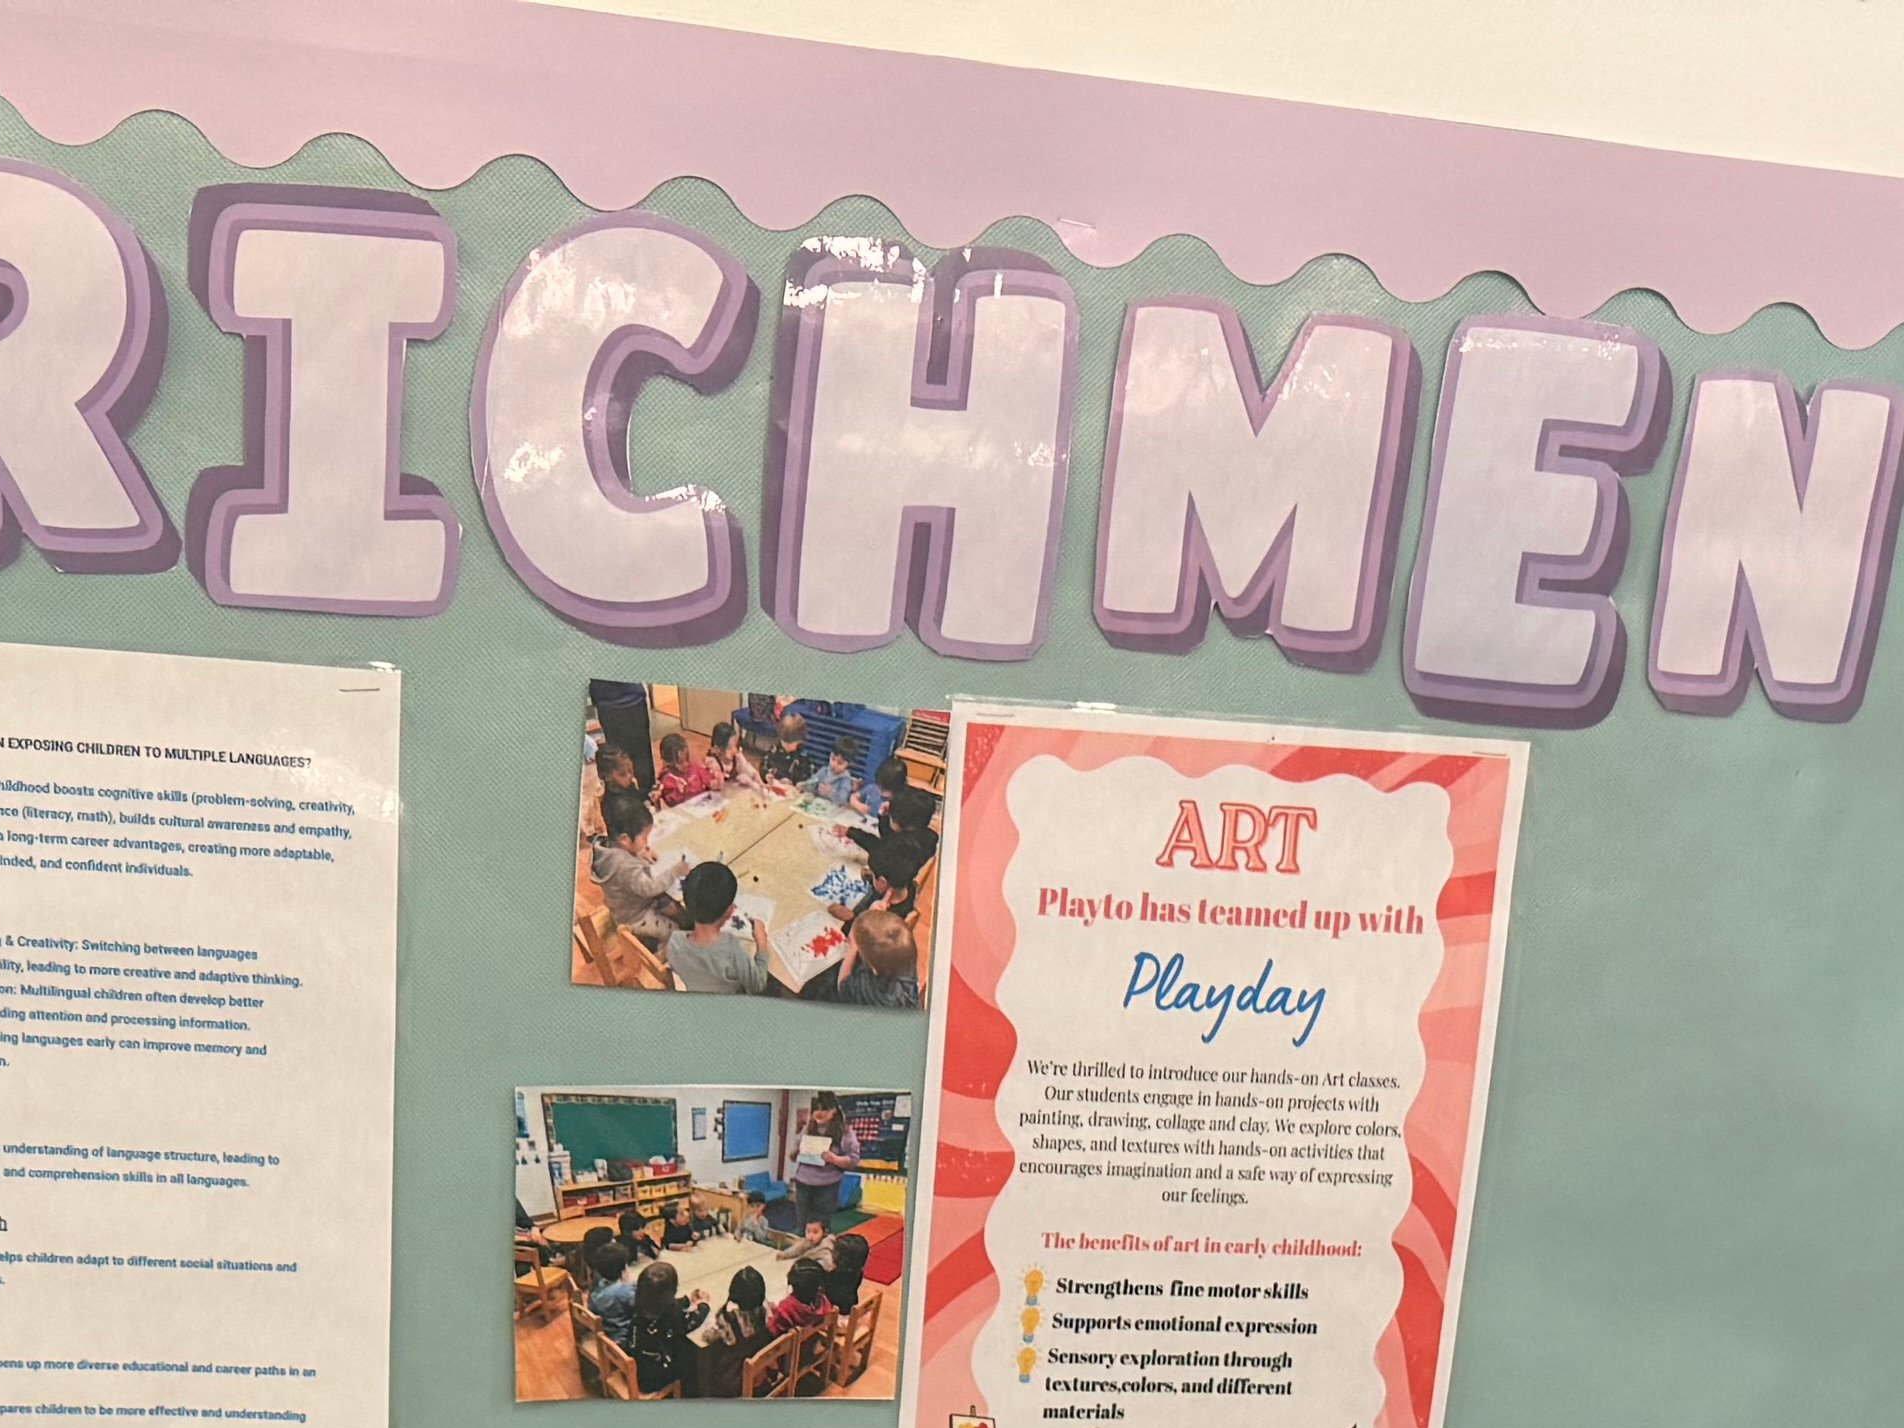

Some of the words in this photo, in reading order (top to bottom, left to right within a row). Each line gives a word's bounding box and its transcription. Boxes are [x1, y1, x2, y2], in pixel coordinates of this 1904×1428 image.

[7, 737, 74, 753] EXPOSING
[76, 741, 141, 758] CHILDREN
[144, 745, 162, 759] TO
[164, 747, 227, 763] MULTIPLE
[229, 751, 312, 768] LANGUAGES?
[1155, 798, 1318, 875] ART
[1038, 887, 1134, 927] Playto
[1139, 891, 1192, 923] has
[1197, 898, 1308, 929] teamed
[1314, 910, 1351, 940] up
[1358, 904, 1424, 935] with
[4, 934, 15, 947] &
[16, 935, 79, 953] Creativity:
[81, 938, 142, 956] Switching
[143, 942, 195, 957] between
[196, 945, 258, 963] languages
[1123, 951, 1328, 1048] Playday
[1027, 1059, 1069, 1077] We're
[1072, 1060, 1126, 1079] thrilled
[1130, 1065, 1145, 1080] to
[1148, 1063, 1219, 1083] introduce
[1222, 1071, 1248, 1084] our
[1249, 1067, 1319, 1086] hands-on
[1321, 1072, 1345, 1088] Art
[1348, 1071, 1401, 1089] classes.
[1041, 1231, 1076, 1250] The
[1078, 1232, 1150, 1252] benefits
[1152, 1234, 1174, 1252] of
[1173, 1237, 1200, 1254] art
[1203, 1236, 1222, 1254] in
[1224, 1237, 1267, 1259] early
[1271, 1237, 1362, 1257] childhood:
[1055, 1277, 1164, 1300] Strengthens
[1170, 1279, 1205, 1298] fine
[1207, 1283, 1262, 1299] motor
[1263, 1282, 1309, 1300] skills
[1051, 1312, 1132, 1335] Supports
[1134, 1315, 1222, 1333] emotional
[1224, 1317, 1318, 1338] expression
[1047, 1347, 1115, 1370] Sensory
[1119, 1348, 1220, 1370] exploration
[1223, 1350, 1293, 1373] through
[1045, 1375, 1178, 1395] textures,colors,
[1180, 1377, 1214, 1394] and
[1216, 1377, 1292, 1396] different
[1042, 1402, 1125, 1420] materials
